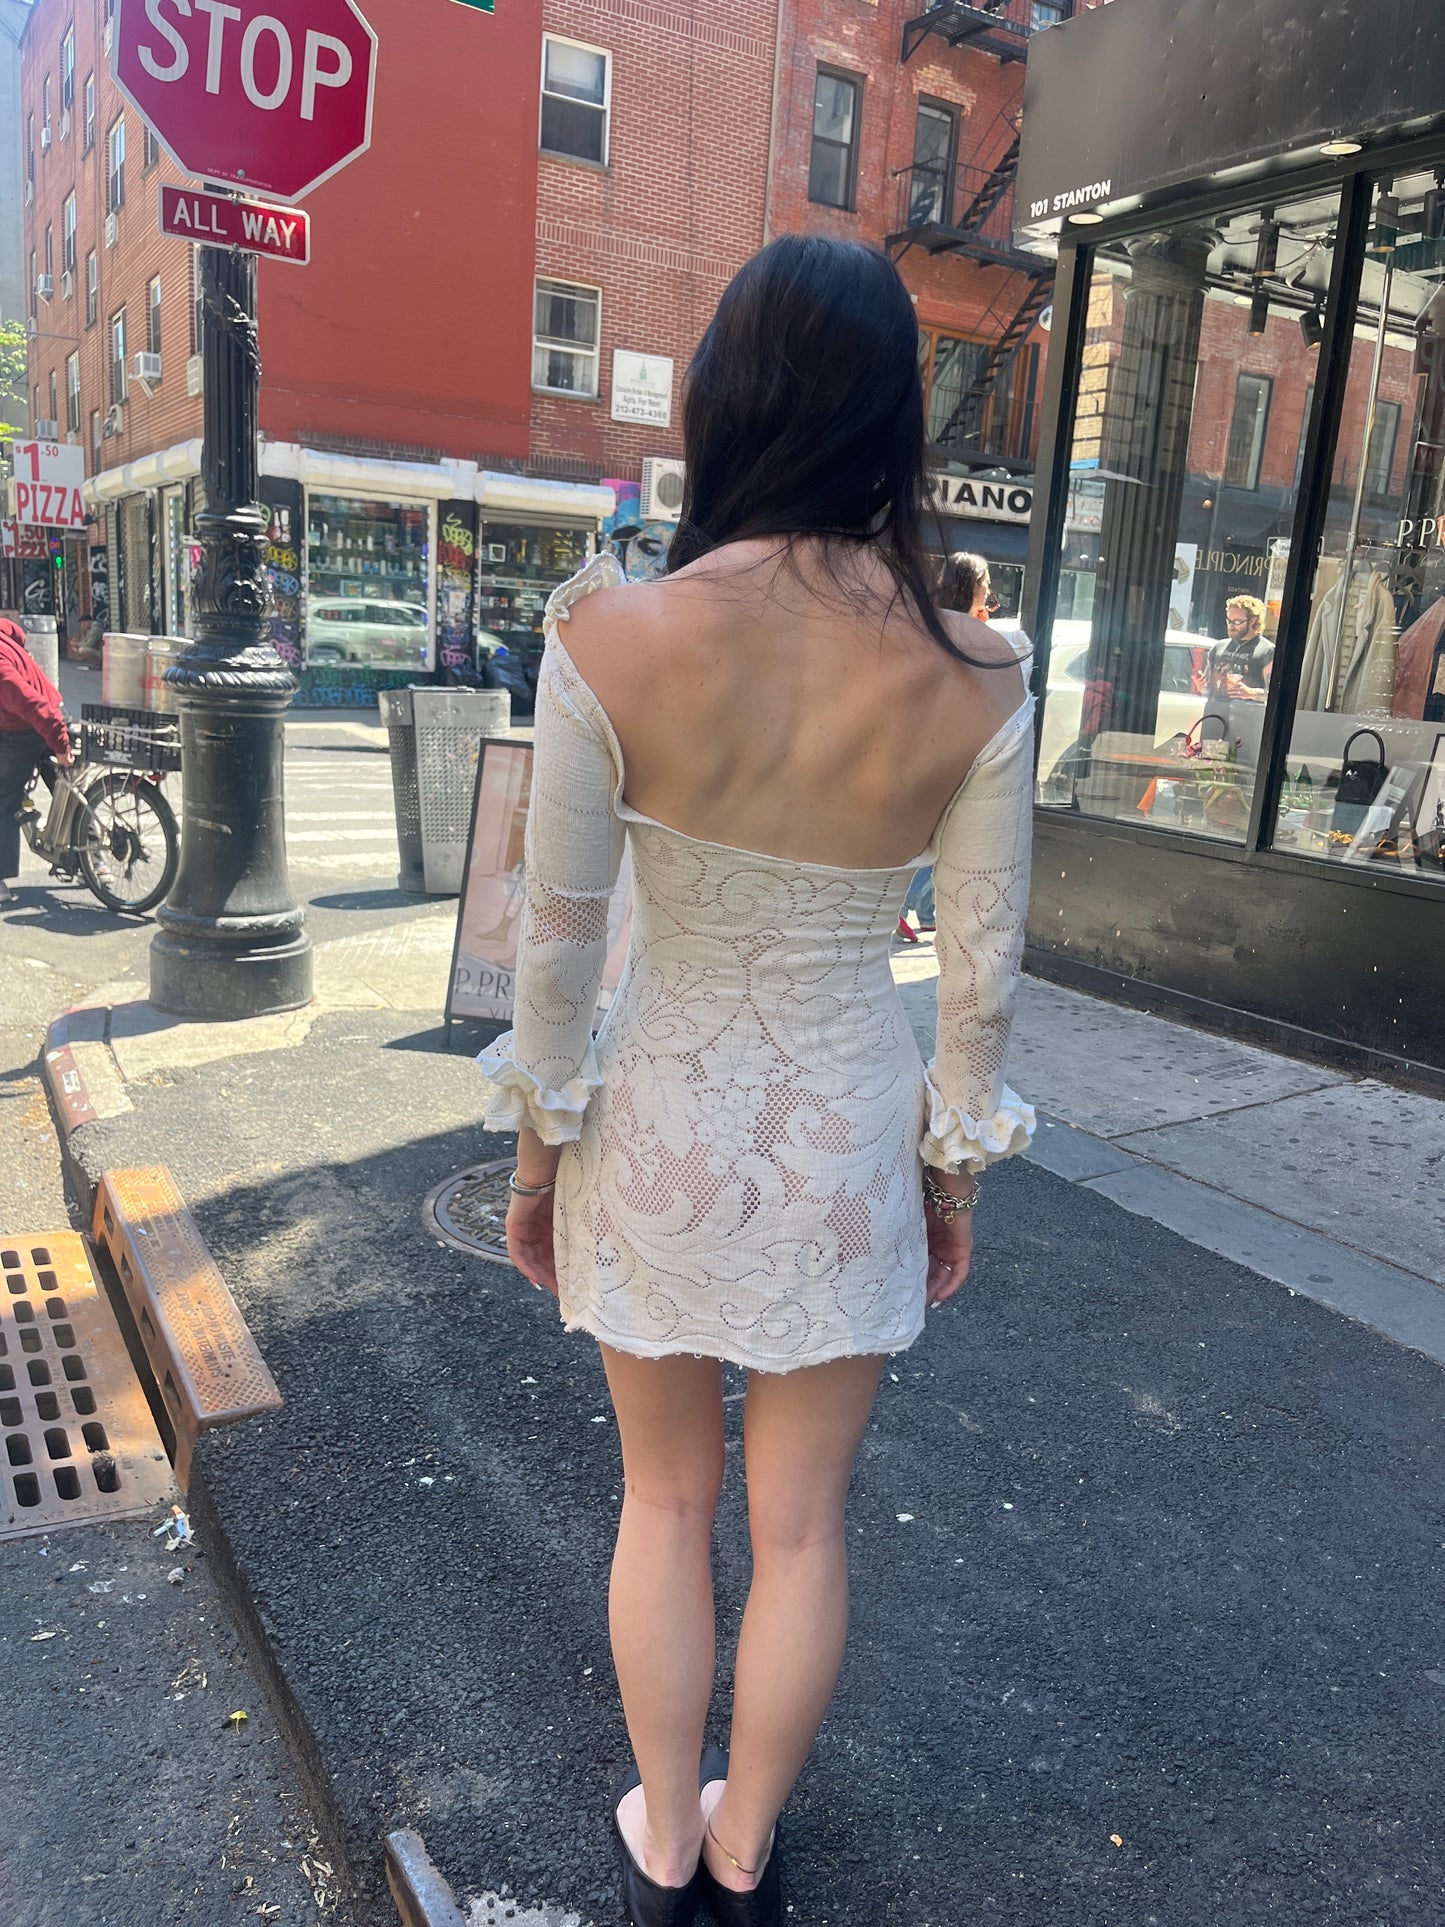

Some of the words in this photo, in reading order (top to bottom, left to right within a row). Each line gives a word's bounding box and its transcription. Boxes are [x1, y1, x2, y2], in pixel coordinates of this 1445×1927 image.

[138, 0, 353, 121] STOP
[1030, 198, 1049, 218] 101
[1052, 179, 1111, 211] STANTON
[173, 197, 228, 235] ALL
[241, 210, 297, 249] WAY
[16, 481, 86, 526] PIZZA
[191, 1328, 225, 1378] WATERWAYS
[213, 1333, 237, 1361] WASTE
